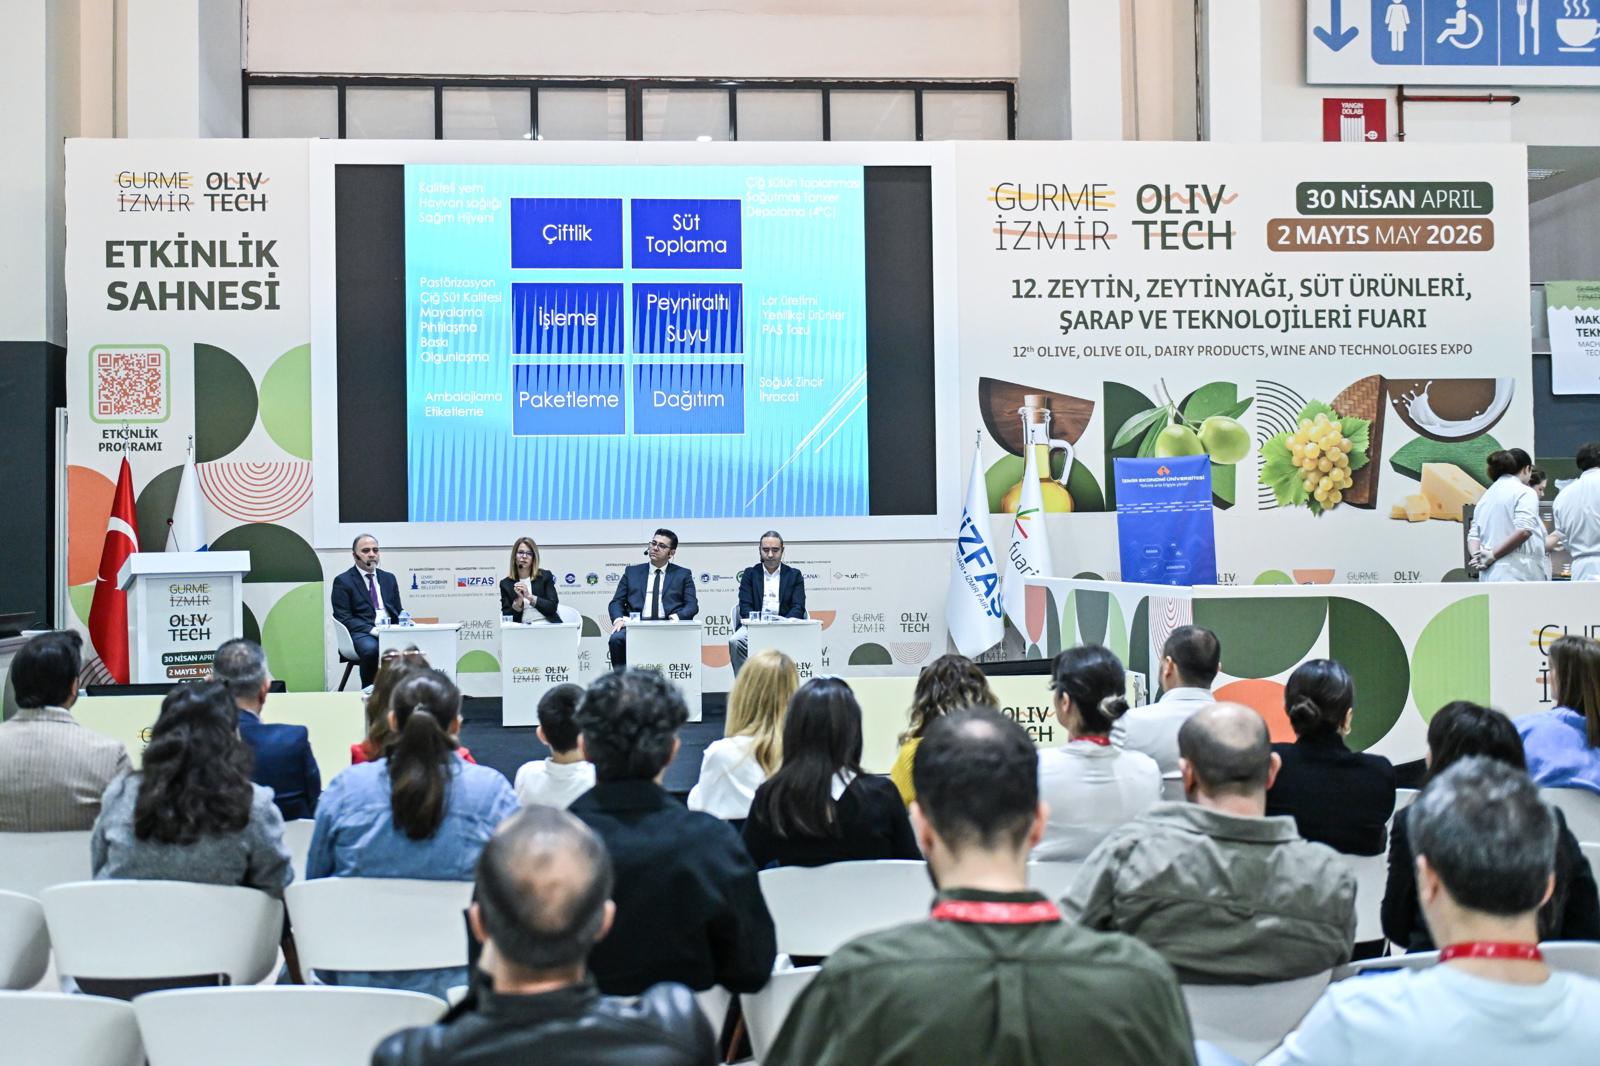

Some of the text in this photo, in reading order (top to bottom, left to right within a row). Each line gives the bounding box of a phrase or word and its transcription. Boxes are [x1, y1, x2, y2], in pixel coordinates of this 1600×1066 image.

[118, 171, 189, 189] GURME
[206, 172, 262, 190] OLIV
[419, 181, 484, 195] Kaliteli yem
[118, 190, 191, 212] İZMİR
[204, 193, 266, 212] TECH
[995, 182, 1109, 211] GURME
[1136, 184, 1226, 214] OLIV
[1306, 184, 1483, 209] 30 NİSAN APRIL
[419, 197, 463, 210] Hayvan
[671, 213, 700, 232] Süt
[542, 224, 593, 244] Çiftlik
[995, 214, 1111, 251] İZMİR
[1131, 220, 1232, 250] TECH
[1277, 225, 1483, 245] 2 MAYIS MAY 2026
[105, 231, 280, 268] ETKİNLİK
[646, 235, 727, 256] Toplama
[419, 277, 496, 290] Pastörizasyon
[1012, 273, 1472, 302] 12. ZEYTİN, ZEYTİNYAĞI, SÜT ÜRÜNLERİ,
[106, 272, 281, 311] SAHNESİ
[419, 291, 502, 304] Çiğ Süt Kalitesi
[646, 293, 729, 314] Peyniraltı
[419, 307, 483, 319] Mayalama
[539, 306, 598, 330] İşleme
[1059, 304, 1427, 335] ŞARAP VE TEKNOLOJİLERİ FUARI
[666, 325, 709, 346] Suyu
[419, 337, 449, 348] Baskı
[1012, 343, 1473, 359] 12th OLIVE, OLIVE OIL, DAIRY PRODUCTS, WINE AND TECHNOLOGIES EXPO
[420, 352, 490, 364] Olgunlaşma
[759, 376, 824, 389] Soğuk Zincir
[425, 391, 503, 404] Ambalajlama
[519, 391, 620, 408] Paketleme
[653, 390, 725, 411] Dağıtım
[424, 406, 484, 417] Etiketleme
[102, 426, 159, 439] ETKİNLİK
[98, 441, 163, 453] PROGRAMI
[467, 577, 495, 587] İZFAŞ
[1217, 572, 1236, 582] LIV
[1393, 571, 1421, 581] OLIV
[169, 584, 209, 594] GURME
[170, 594, 209, 607] İZMİR
[169, 613, 207, 627] OLIV
[705, 615, 732, 625] OLIV
[852, 613, 885, 622] GURME
[900, 612, 928, 622] OLIV
[168, 628, 210, 641] TECH
[704, 626, 734, 636] TECH
[900, 623, 930, 633] TECH
[164, 655, 174, 663] 30
[174, 653, 198, 663] NİSAN
[174, 668, 197, 676] MAYIS
[545, 666, 567, 674] OLIV
[668, 663, 690, 671] OLIV
[796, 662, 812, 670] LIV
[545, 674, 569, 682] TECH
[668, 672, 692, 680] TECH
[1001, 706, 1049, 723] OLIV
[1026, 726, 1053, 742] CH
